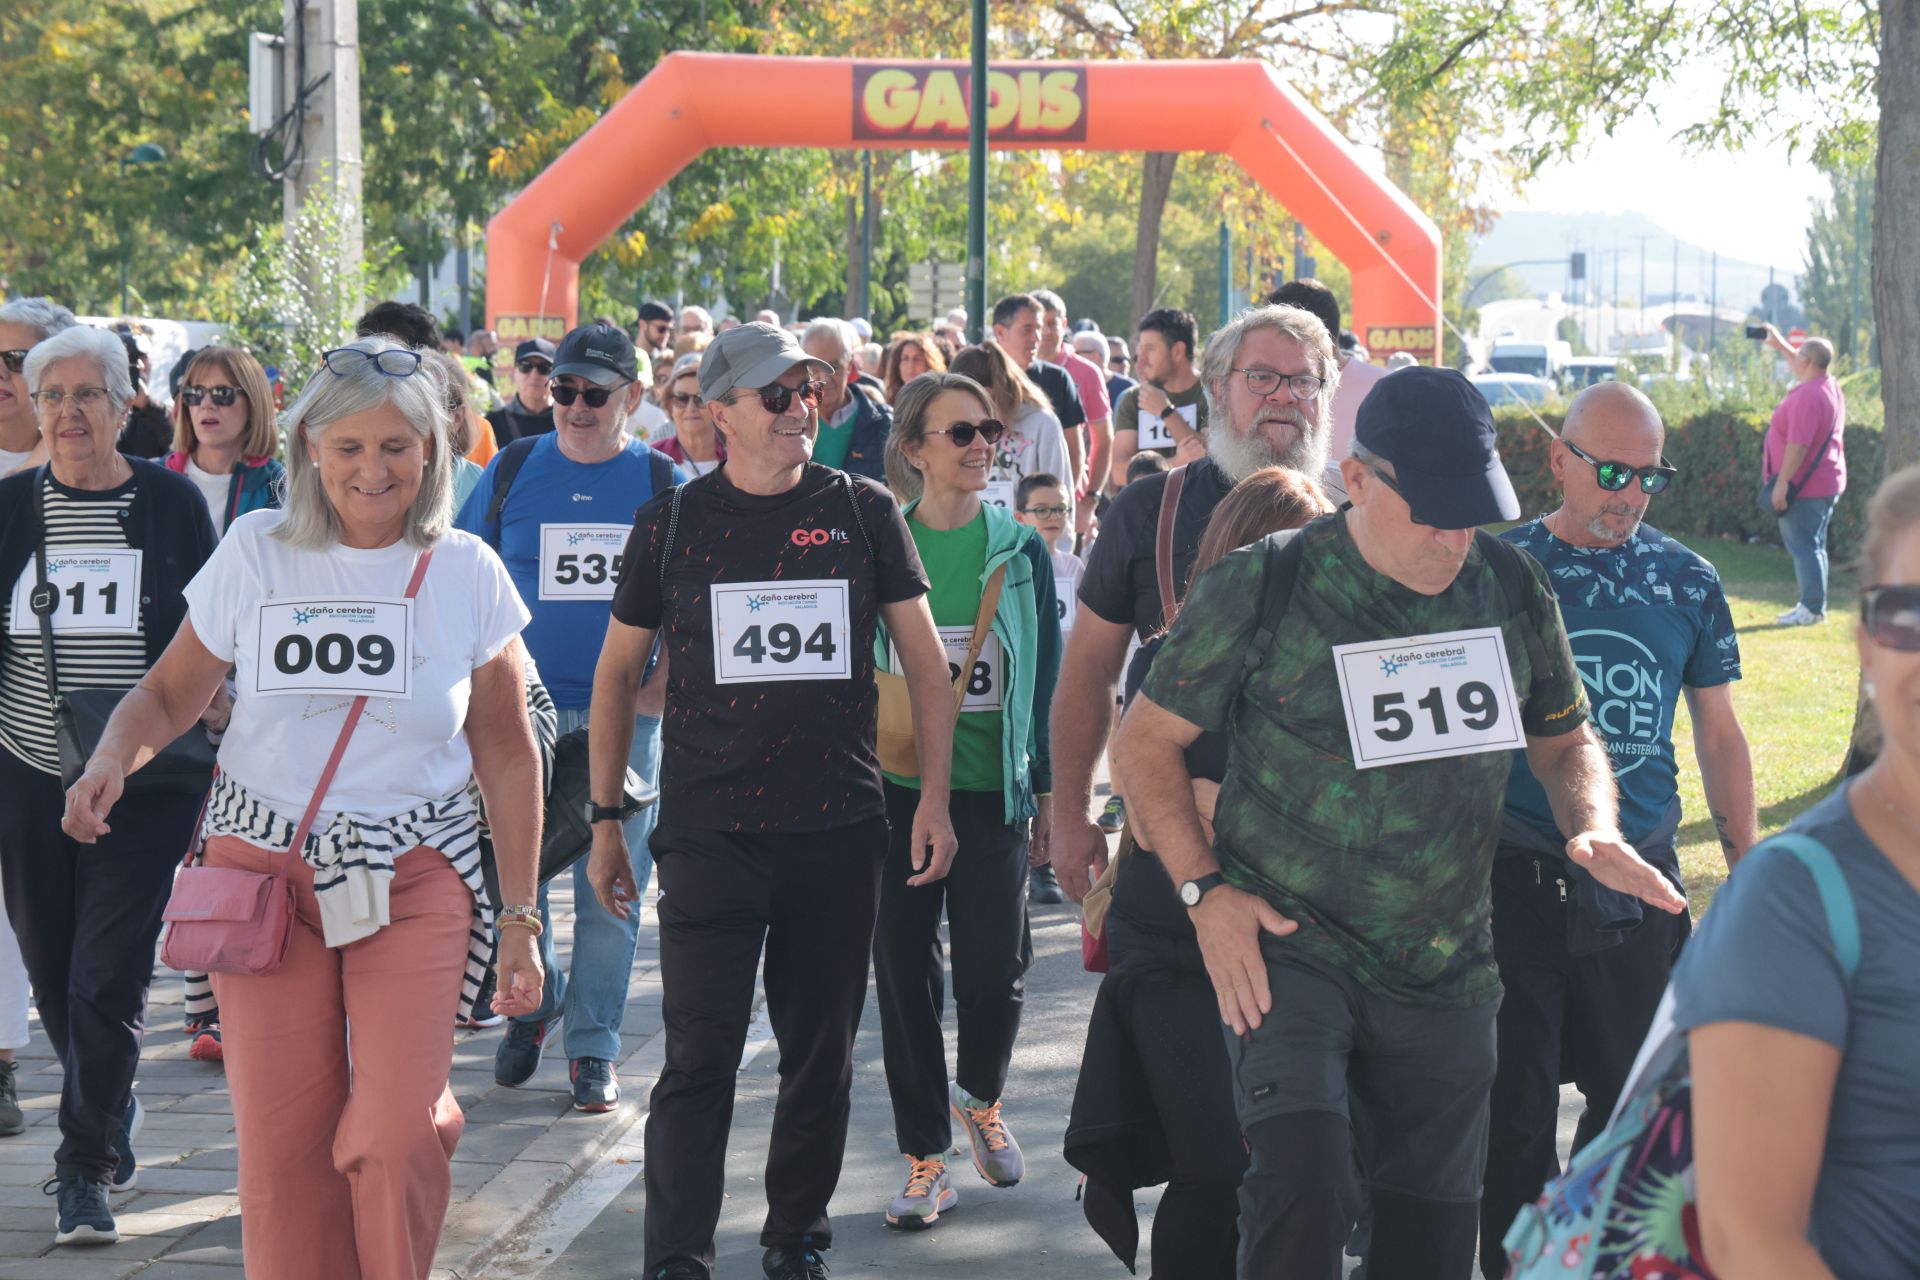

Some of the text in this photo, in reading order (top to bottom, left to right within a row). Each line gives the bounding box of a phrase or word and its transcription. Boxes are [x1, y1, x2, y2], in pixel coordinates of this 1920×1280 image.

[863, 69, 1082, 136] GADIS
[595, 531, 623, 539] cerebral
[58, 557, 112, 566] daño cerebral
[30, 581, 118, 616] 011
[310, 606, 376, 615] daño cerebral
[760, 592, 818, 602] daño cerebral
[274, 632, 395, 676] 009
[733, 622, 837, 664] 494
[1396, 645, 1466, 664] daño cerebral
[1372, 680, 1500, 743] 519
[1589, 698, 1654, 738] CE
[1625, 742, 1661, 756] ESTEBAN
